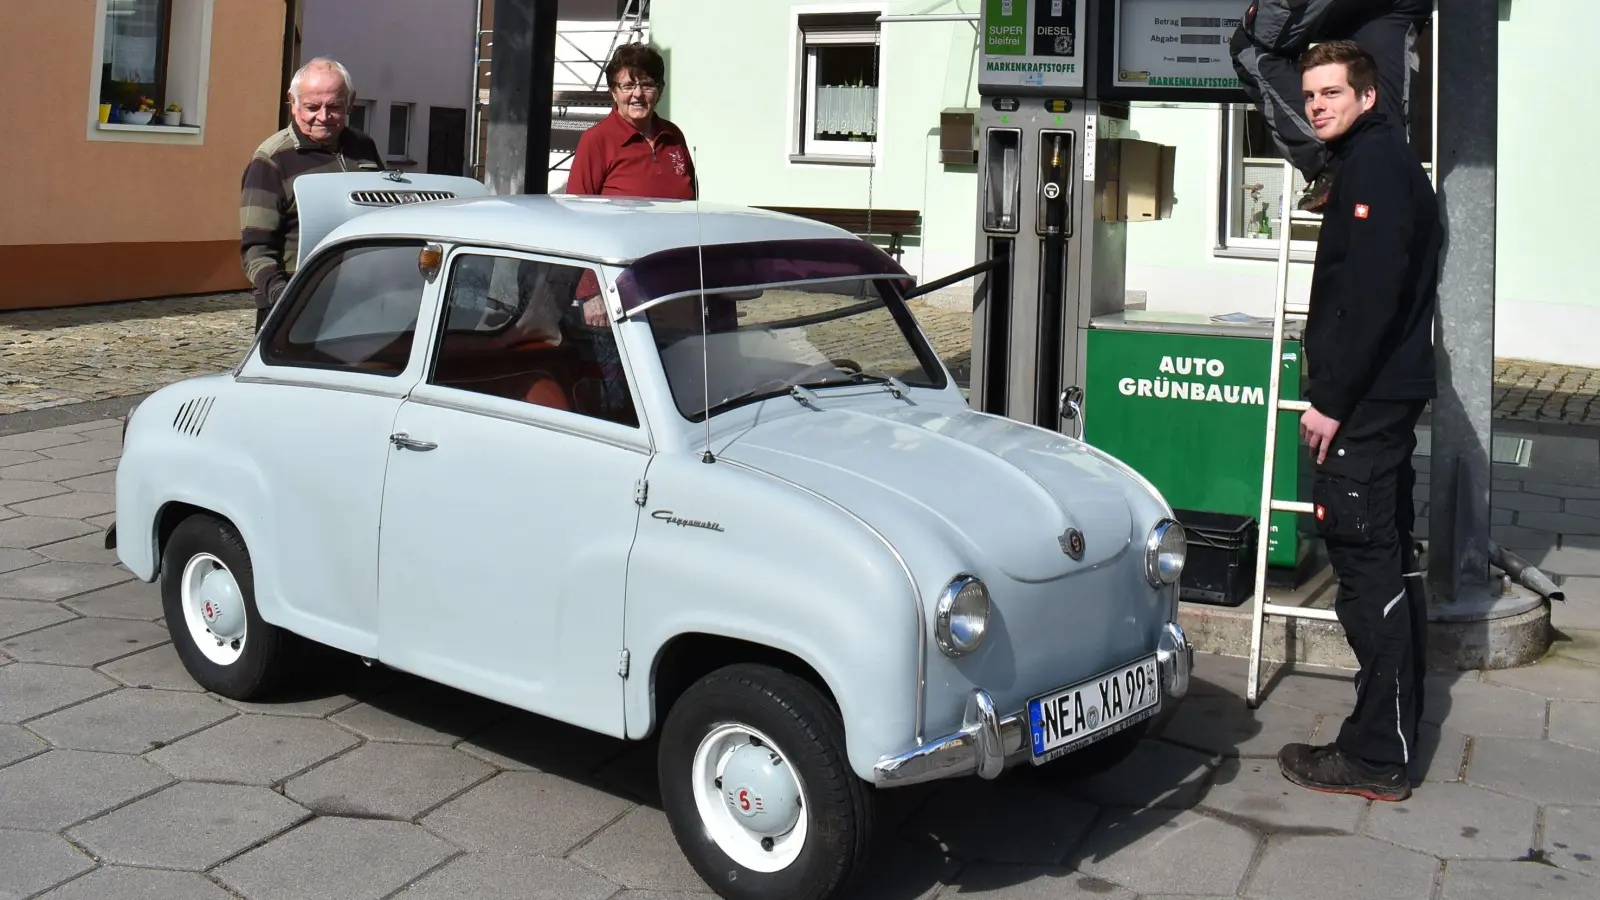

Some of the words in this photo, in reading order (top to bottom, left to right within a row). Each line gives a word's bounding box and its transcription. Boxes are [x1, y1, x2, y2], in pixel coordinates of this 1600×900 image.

[1154, 17, 1179, 27] Betrag
[989, 26, 1023, 35] SUPER
[1037, 26, 1073, 36] DIESEL
[989, 36, 1020, 45] bleifrei
[1150, 34, 1179, 43] Abgabe
[986, 61, 1075, 73] MARKENKRAFTSTOFFE
[1158, 355, 1225, 377] AUTO
[1118, 376, 1265, 405] GRÜNBAUM
[1043, 690, 1086, 744] NEA
